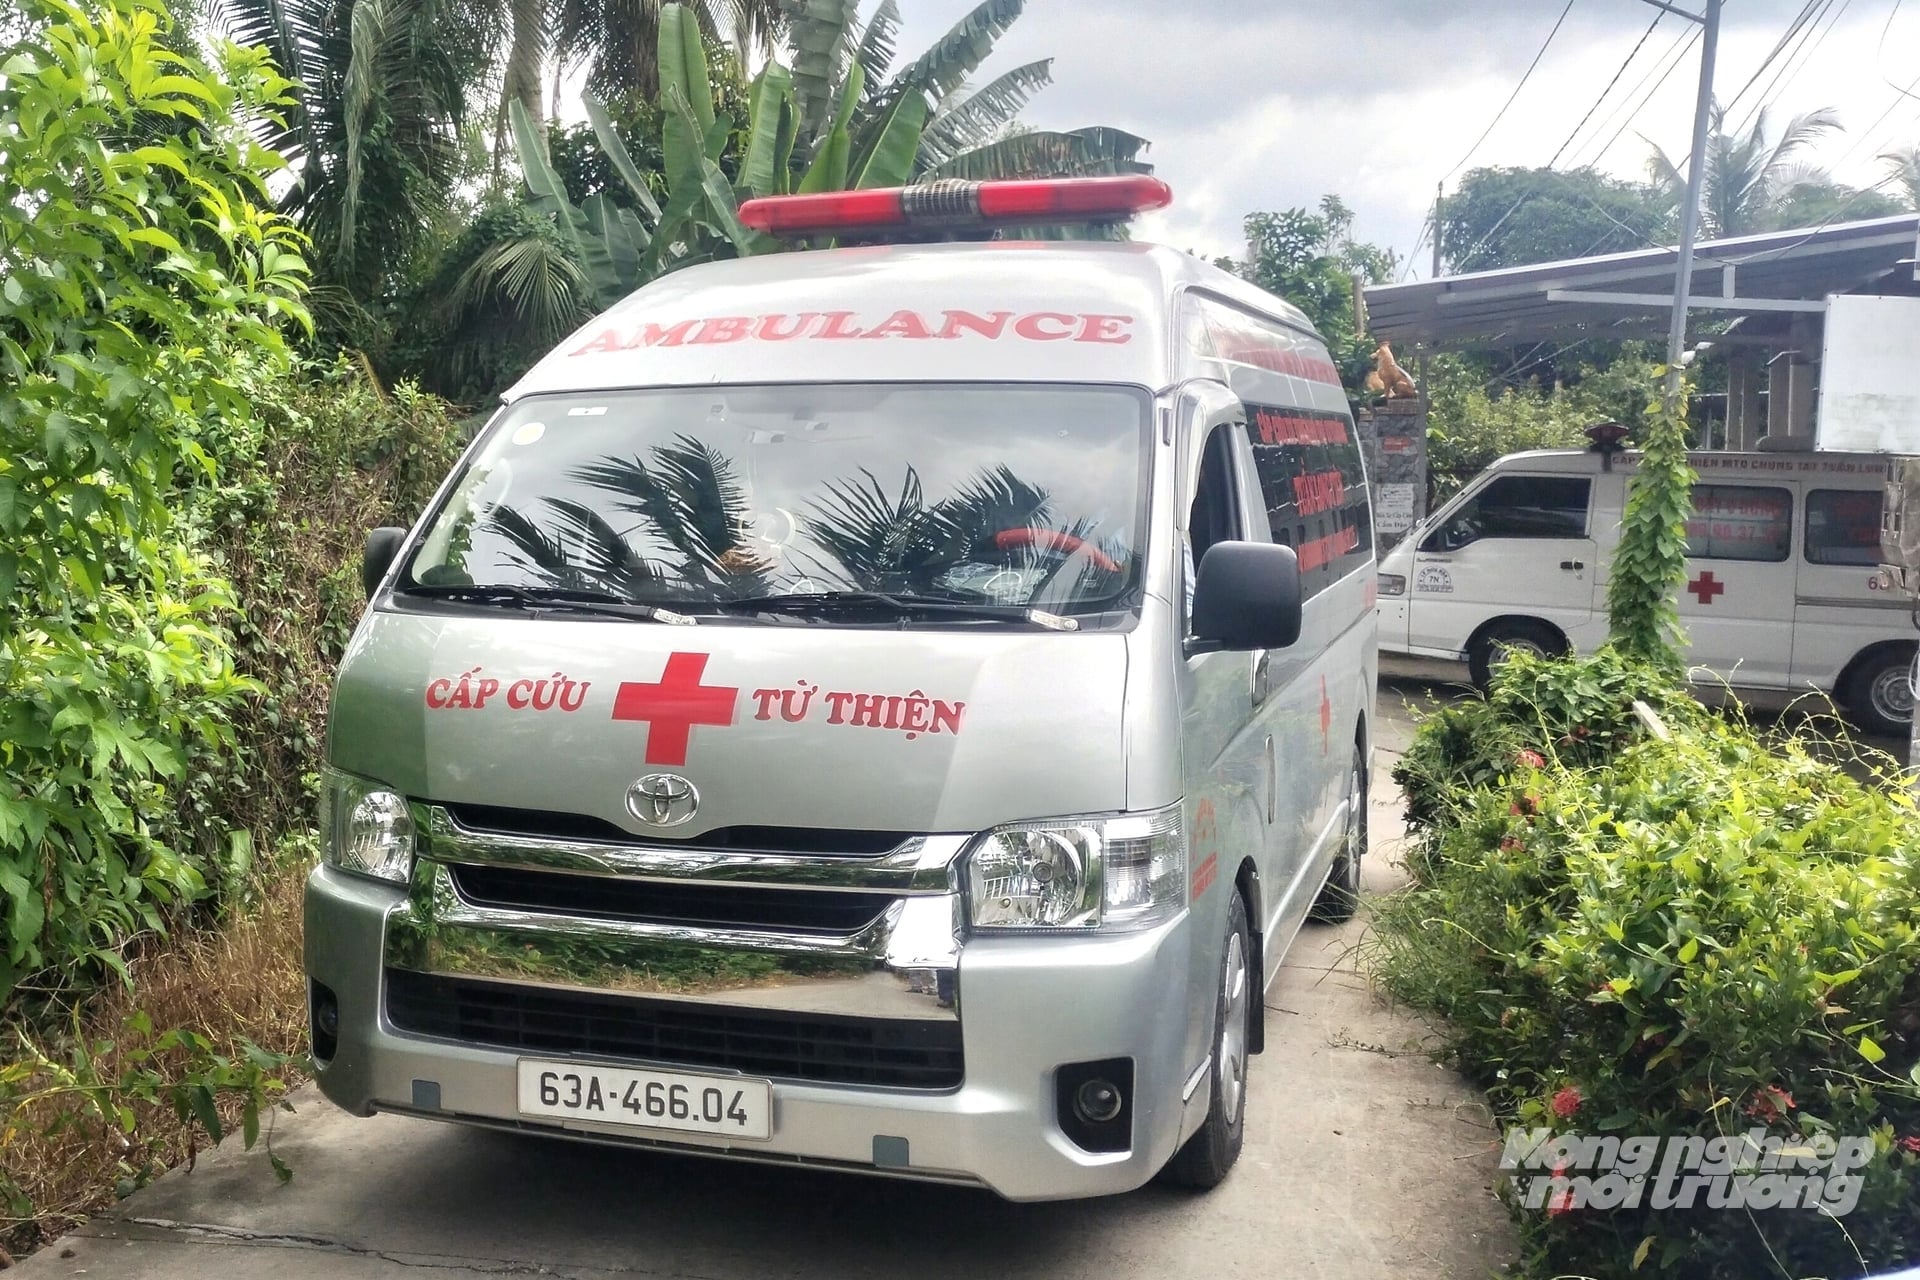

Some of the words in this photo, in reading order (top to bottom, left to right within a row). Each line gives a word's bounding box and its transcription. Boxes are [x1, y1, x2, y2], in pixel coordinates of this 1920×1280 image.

[568, 309, 1134, 357] AMBULANCE
[425, 666, 499, 710] CẤP
[506, 671, 592, 713] CỨU
[752, 679, 818, 723] TỪ
[824, 689, 966, 740] THIỆN
[540, 1071, 748, 1126] 63A-466.04
